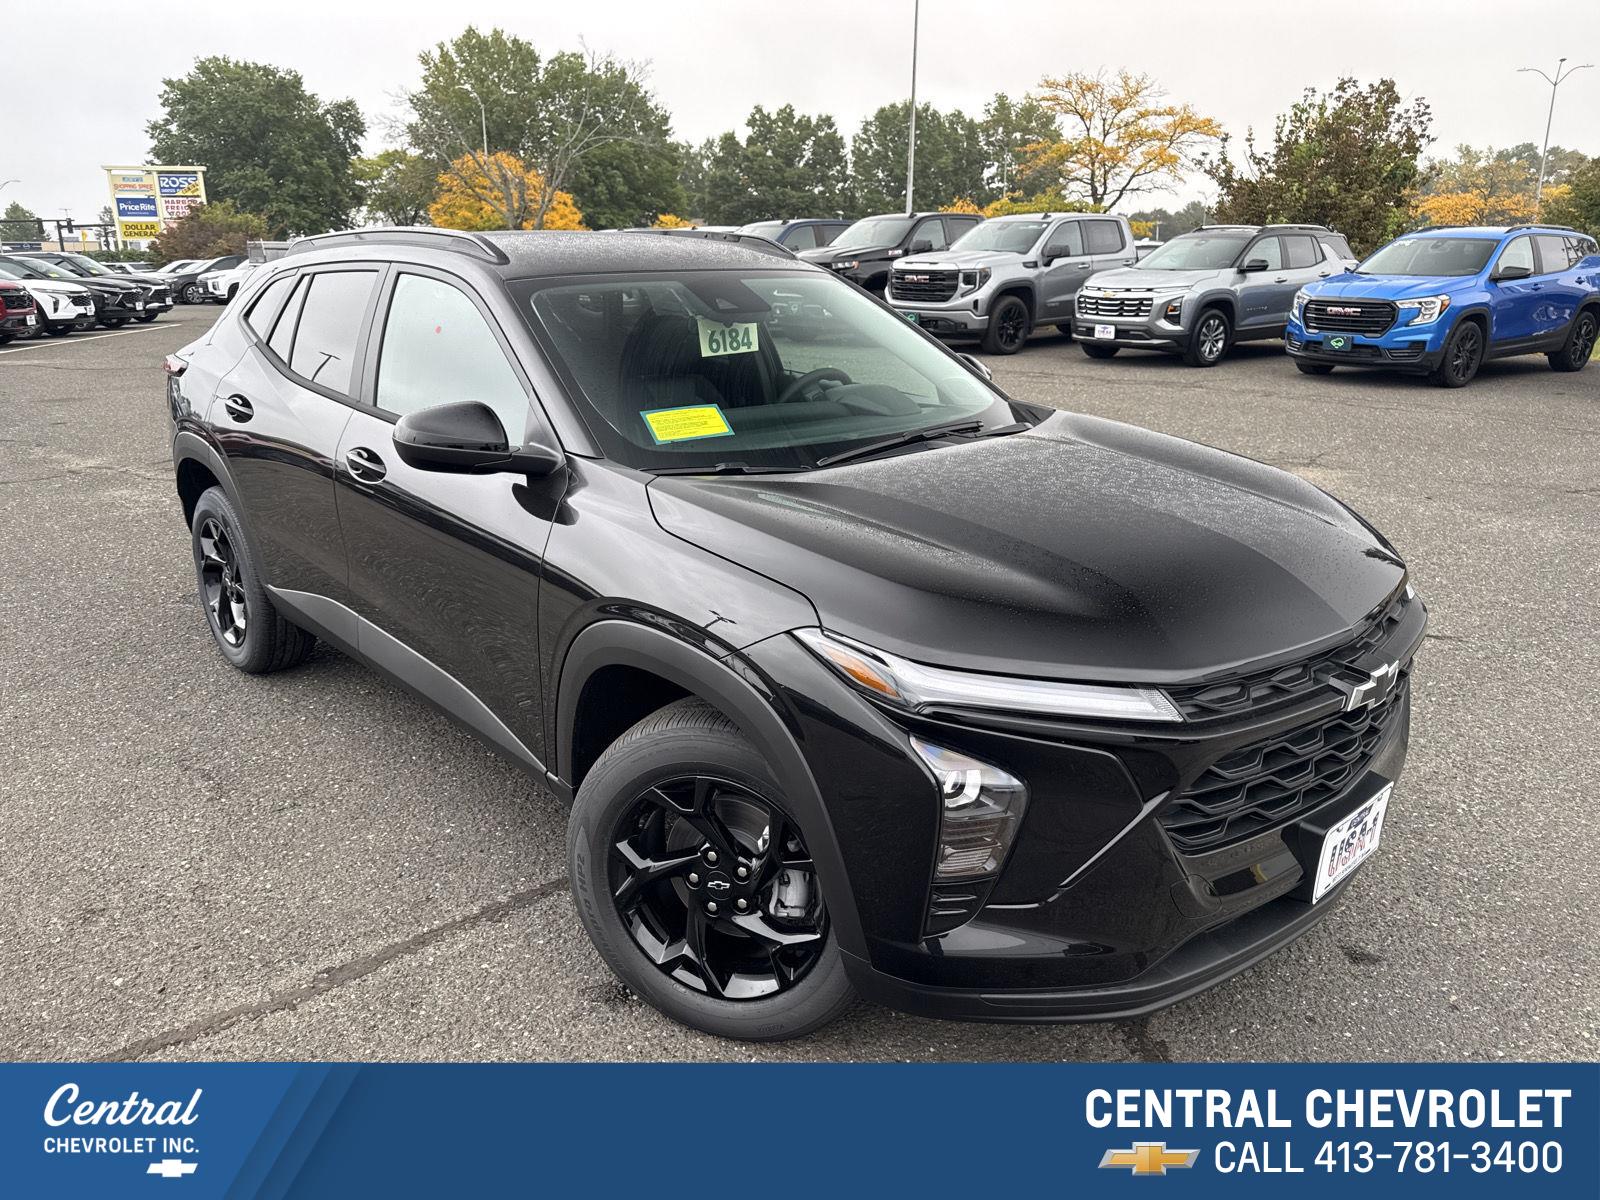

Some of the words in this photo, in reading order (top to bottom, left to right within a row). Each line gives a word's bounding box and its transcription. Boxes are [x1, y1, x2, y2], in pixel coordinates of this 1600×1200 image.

[160, 177, 196, 187] ROSS
[905, 275, 930, 283] GMC
[1327, 307, 1362, 316] GMC
[708, 326, 752, 353] 6184
[1328, 811, 1380, 877] USA-1
